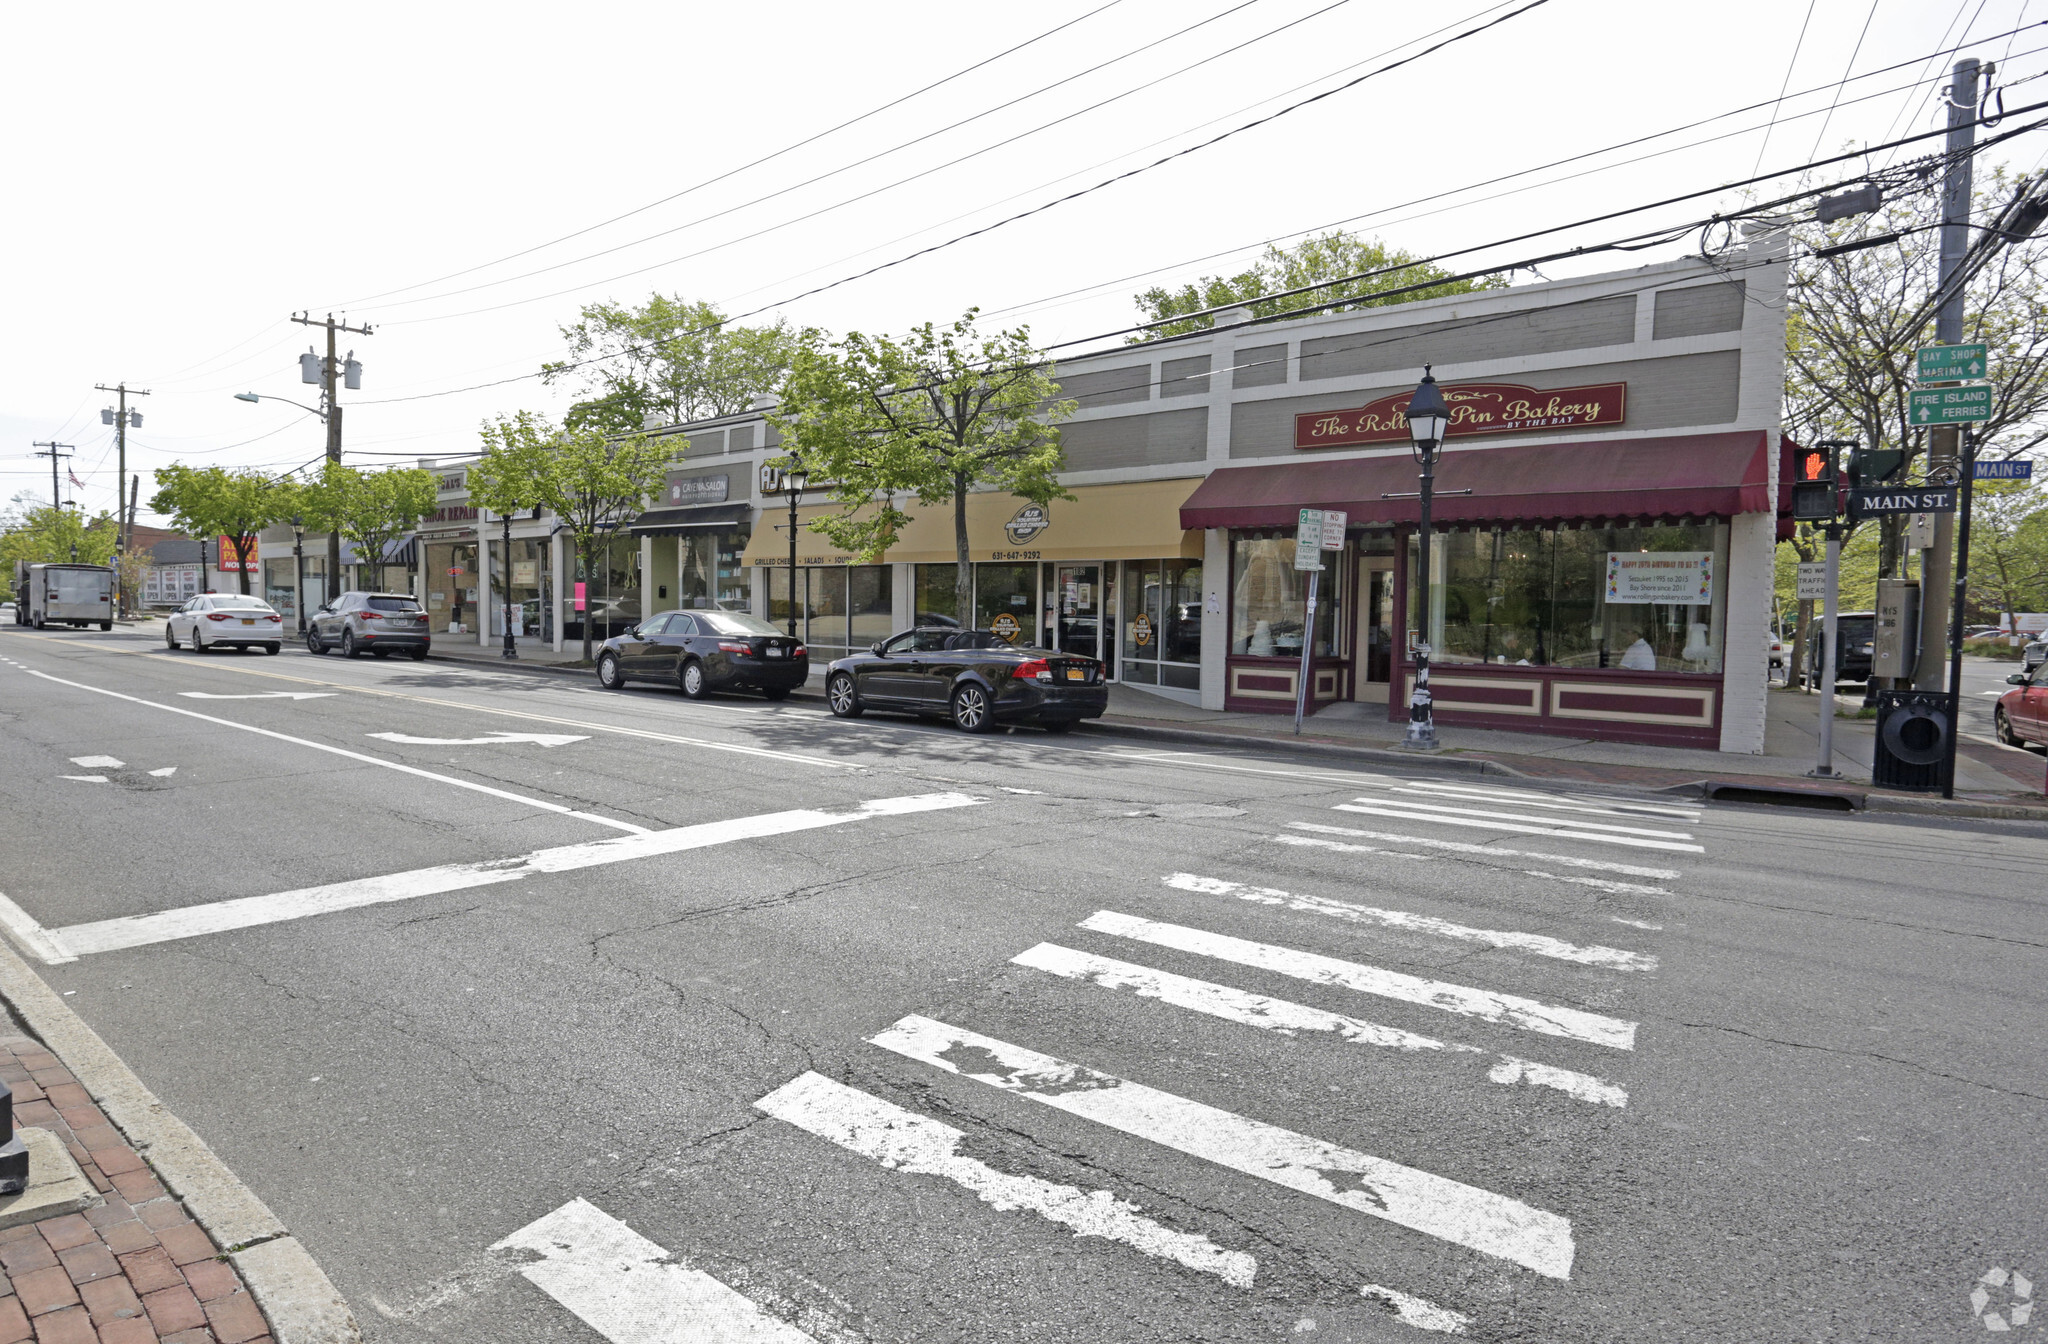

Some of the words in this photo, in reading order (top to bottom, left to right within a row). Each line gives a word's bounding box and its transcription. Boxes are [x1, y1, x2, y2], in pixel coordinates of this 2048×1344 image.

[1922, 352, 1942, 362] BAY
[1950, 349, 1982, 360] SHORE
[1922, 366, 1964, 378] MARINA
[1914, 394, 1940, 405] FIRE
[1944, 391, 1987, 403] ISLAND
[1311, 414, 1350, 437] The
[1447, 405, 1495, 425] Pin
[1502, 396, 1602, 421] Bakery
[1942, 406, 1987, 417] FERRIES
[1506, 421, 1521, 429] BY
[1525, 418, 1547, 427] THE
[1551, 415, 1574, 425] BAY
[1976, 463, 2013, 477] MAIN
[2015, 465, 2028, 475] ST
[441, 478, 461, 490] SAL'S
[705, 480, 726, 491] SALON
[1863, 495, 1918, 510] MAIN
[1922, 493, 1949, 507] ST.
[448, 505, 478, 521] REPAIR
[1301, 513, 1307, 523] 2
[754, 558, 776, 566] GRILLED
[777, 557, 791, 565] CHEE
[804, 557, 825, 565] SALADS
[1629, 584, 1640, 592] Bay
